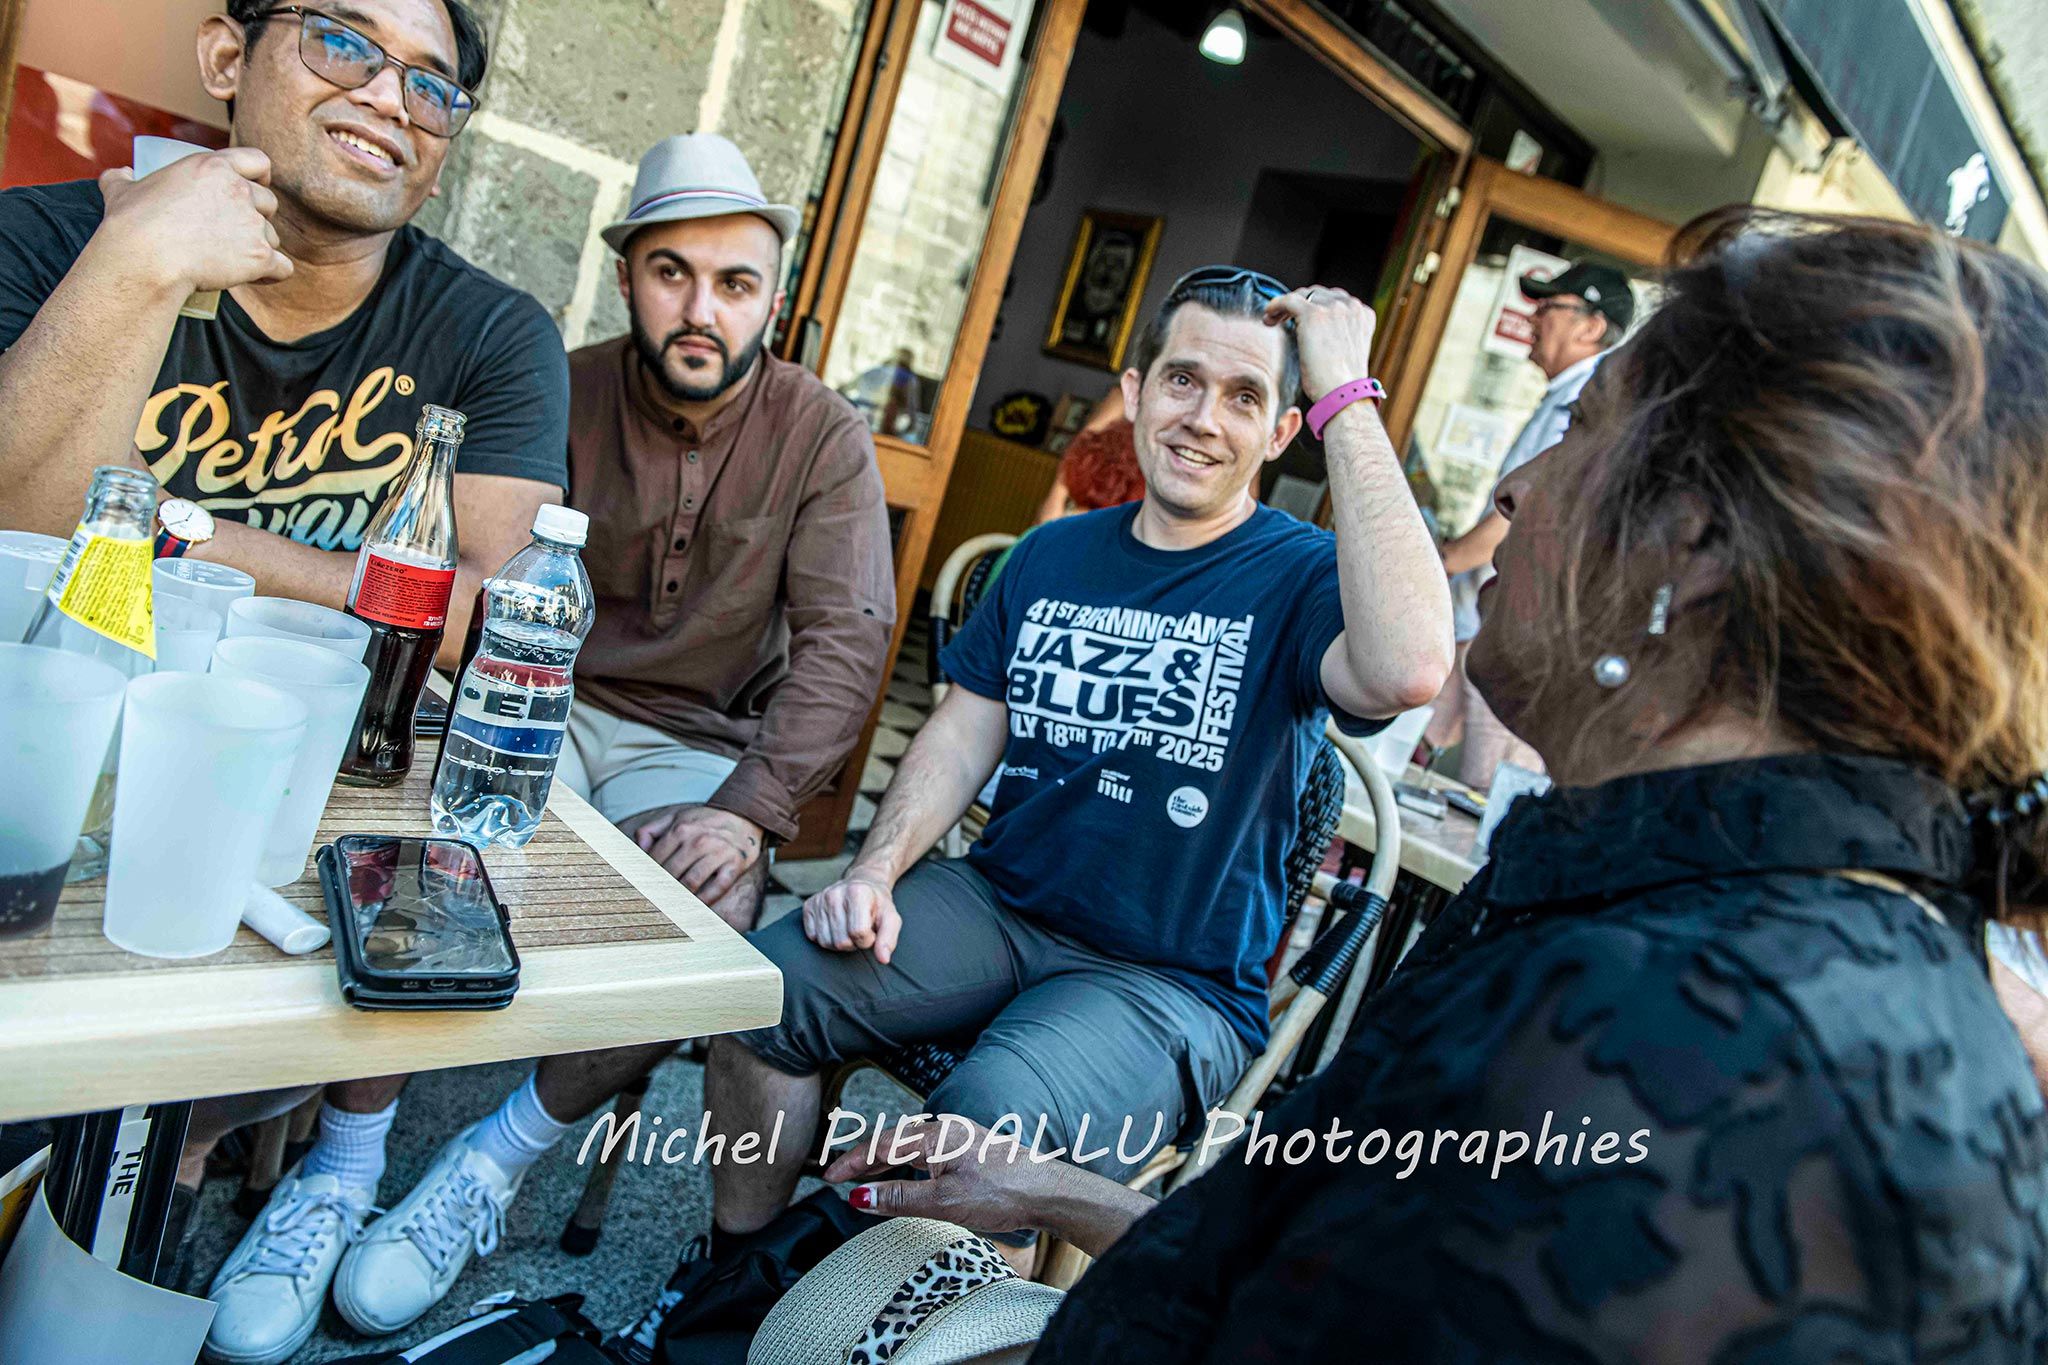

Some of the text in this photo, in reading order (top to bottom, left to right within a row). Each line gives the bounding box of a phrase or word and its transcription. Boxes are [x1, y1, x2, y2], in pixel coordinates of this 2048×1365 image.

[134, 366, 414, 494] Petrol
[1015, 630, 1203, 685] JAZZ &
[1199, 614, 1254, 747] FESTIVAL
[1007, 667, 1196, 728] BLUES
[1043, 720, 1087, 748] 18TH
[1155, 734, 1225, 773] 2025
[110, 1146, 146, 1197] THE
